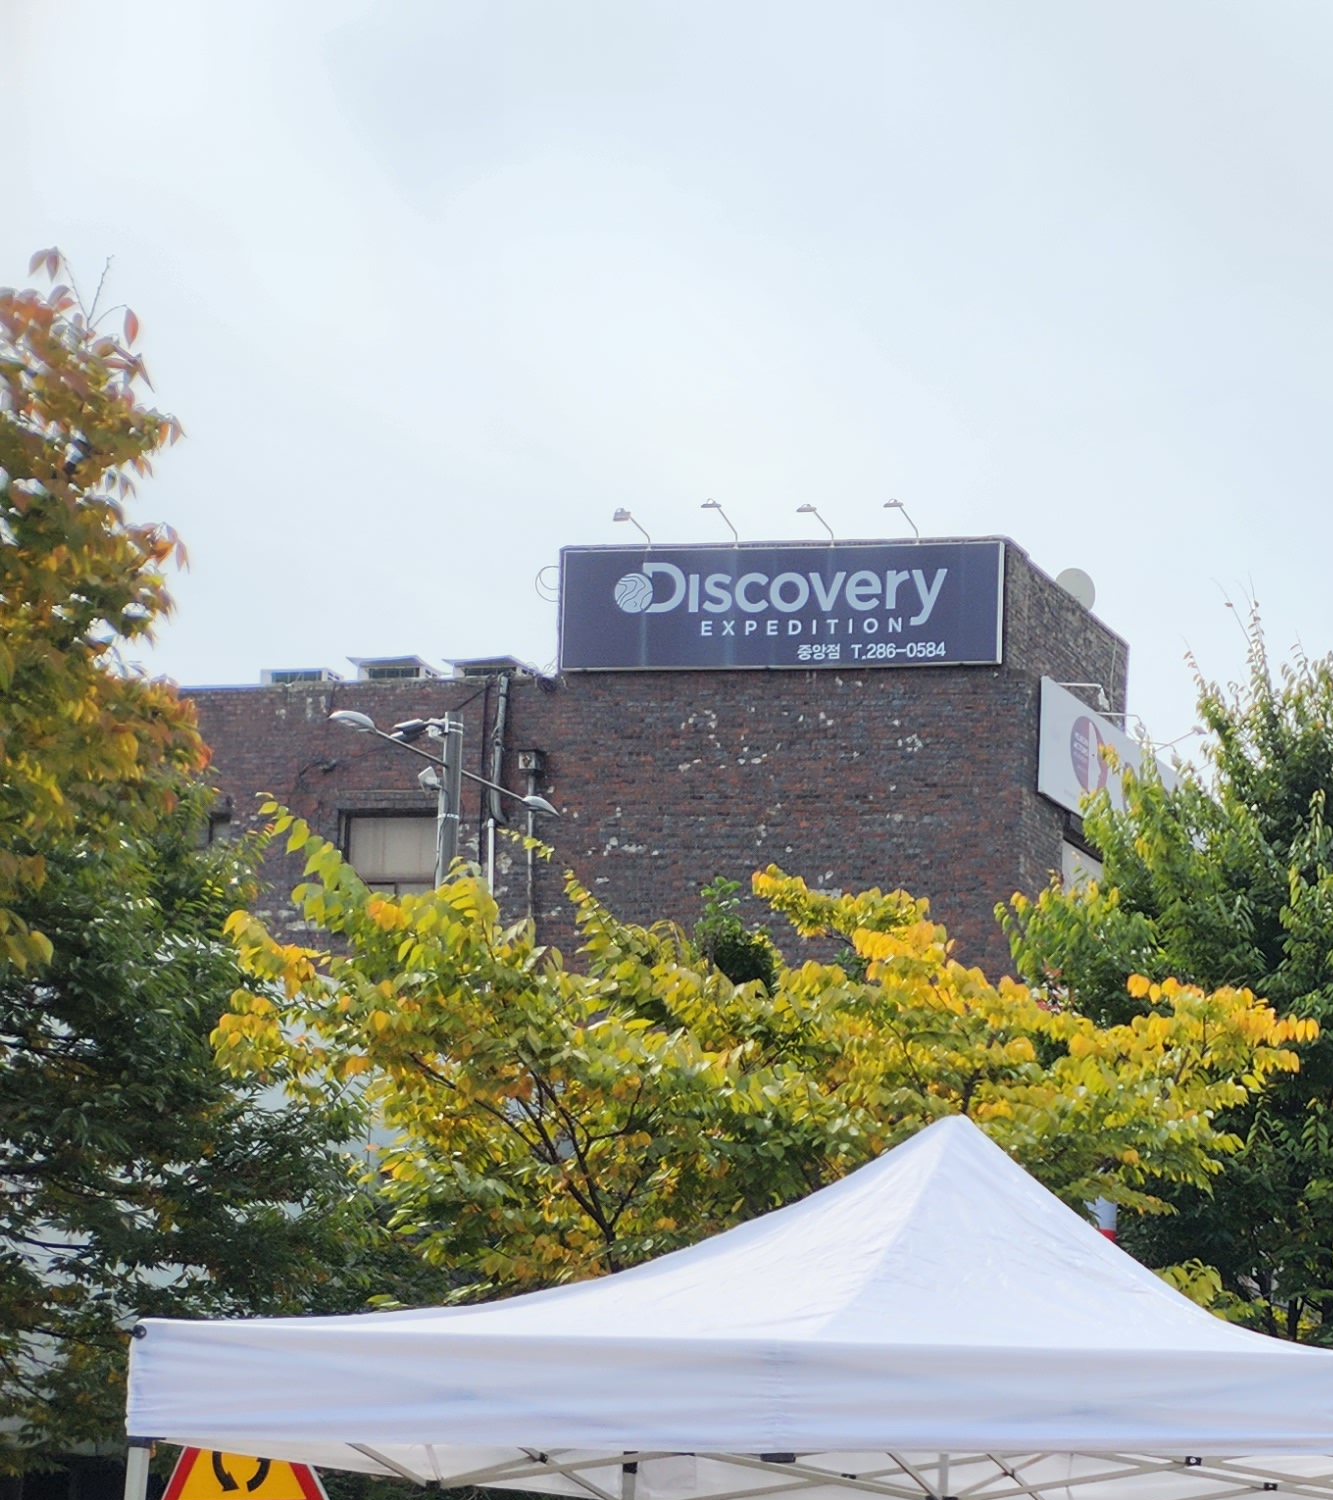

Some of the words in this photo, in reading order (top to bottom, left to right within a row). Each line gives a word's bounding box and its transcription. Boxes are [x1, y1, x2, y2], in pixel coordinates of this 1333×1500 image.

[643, 562, 948, 626] Discovery
[701, 617, 903, 637] EXPEDITION
[796, 643, 841, 661] 중앙점
[850, 641, 947, 661] T.286-0584
